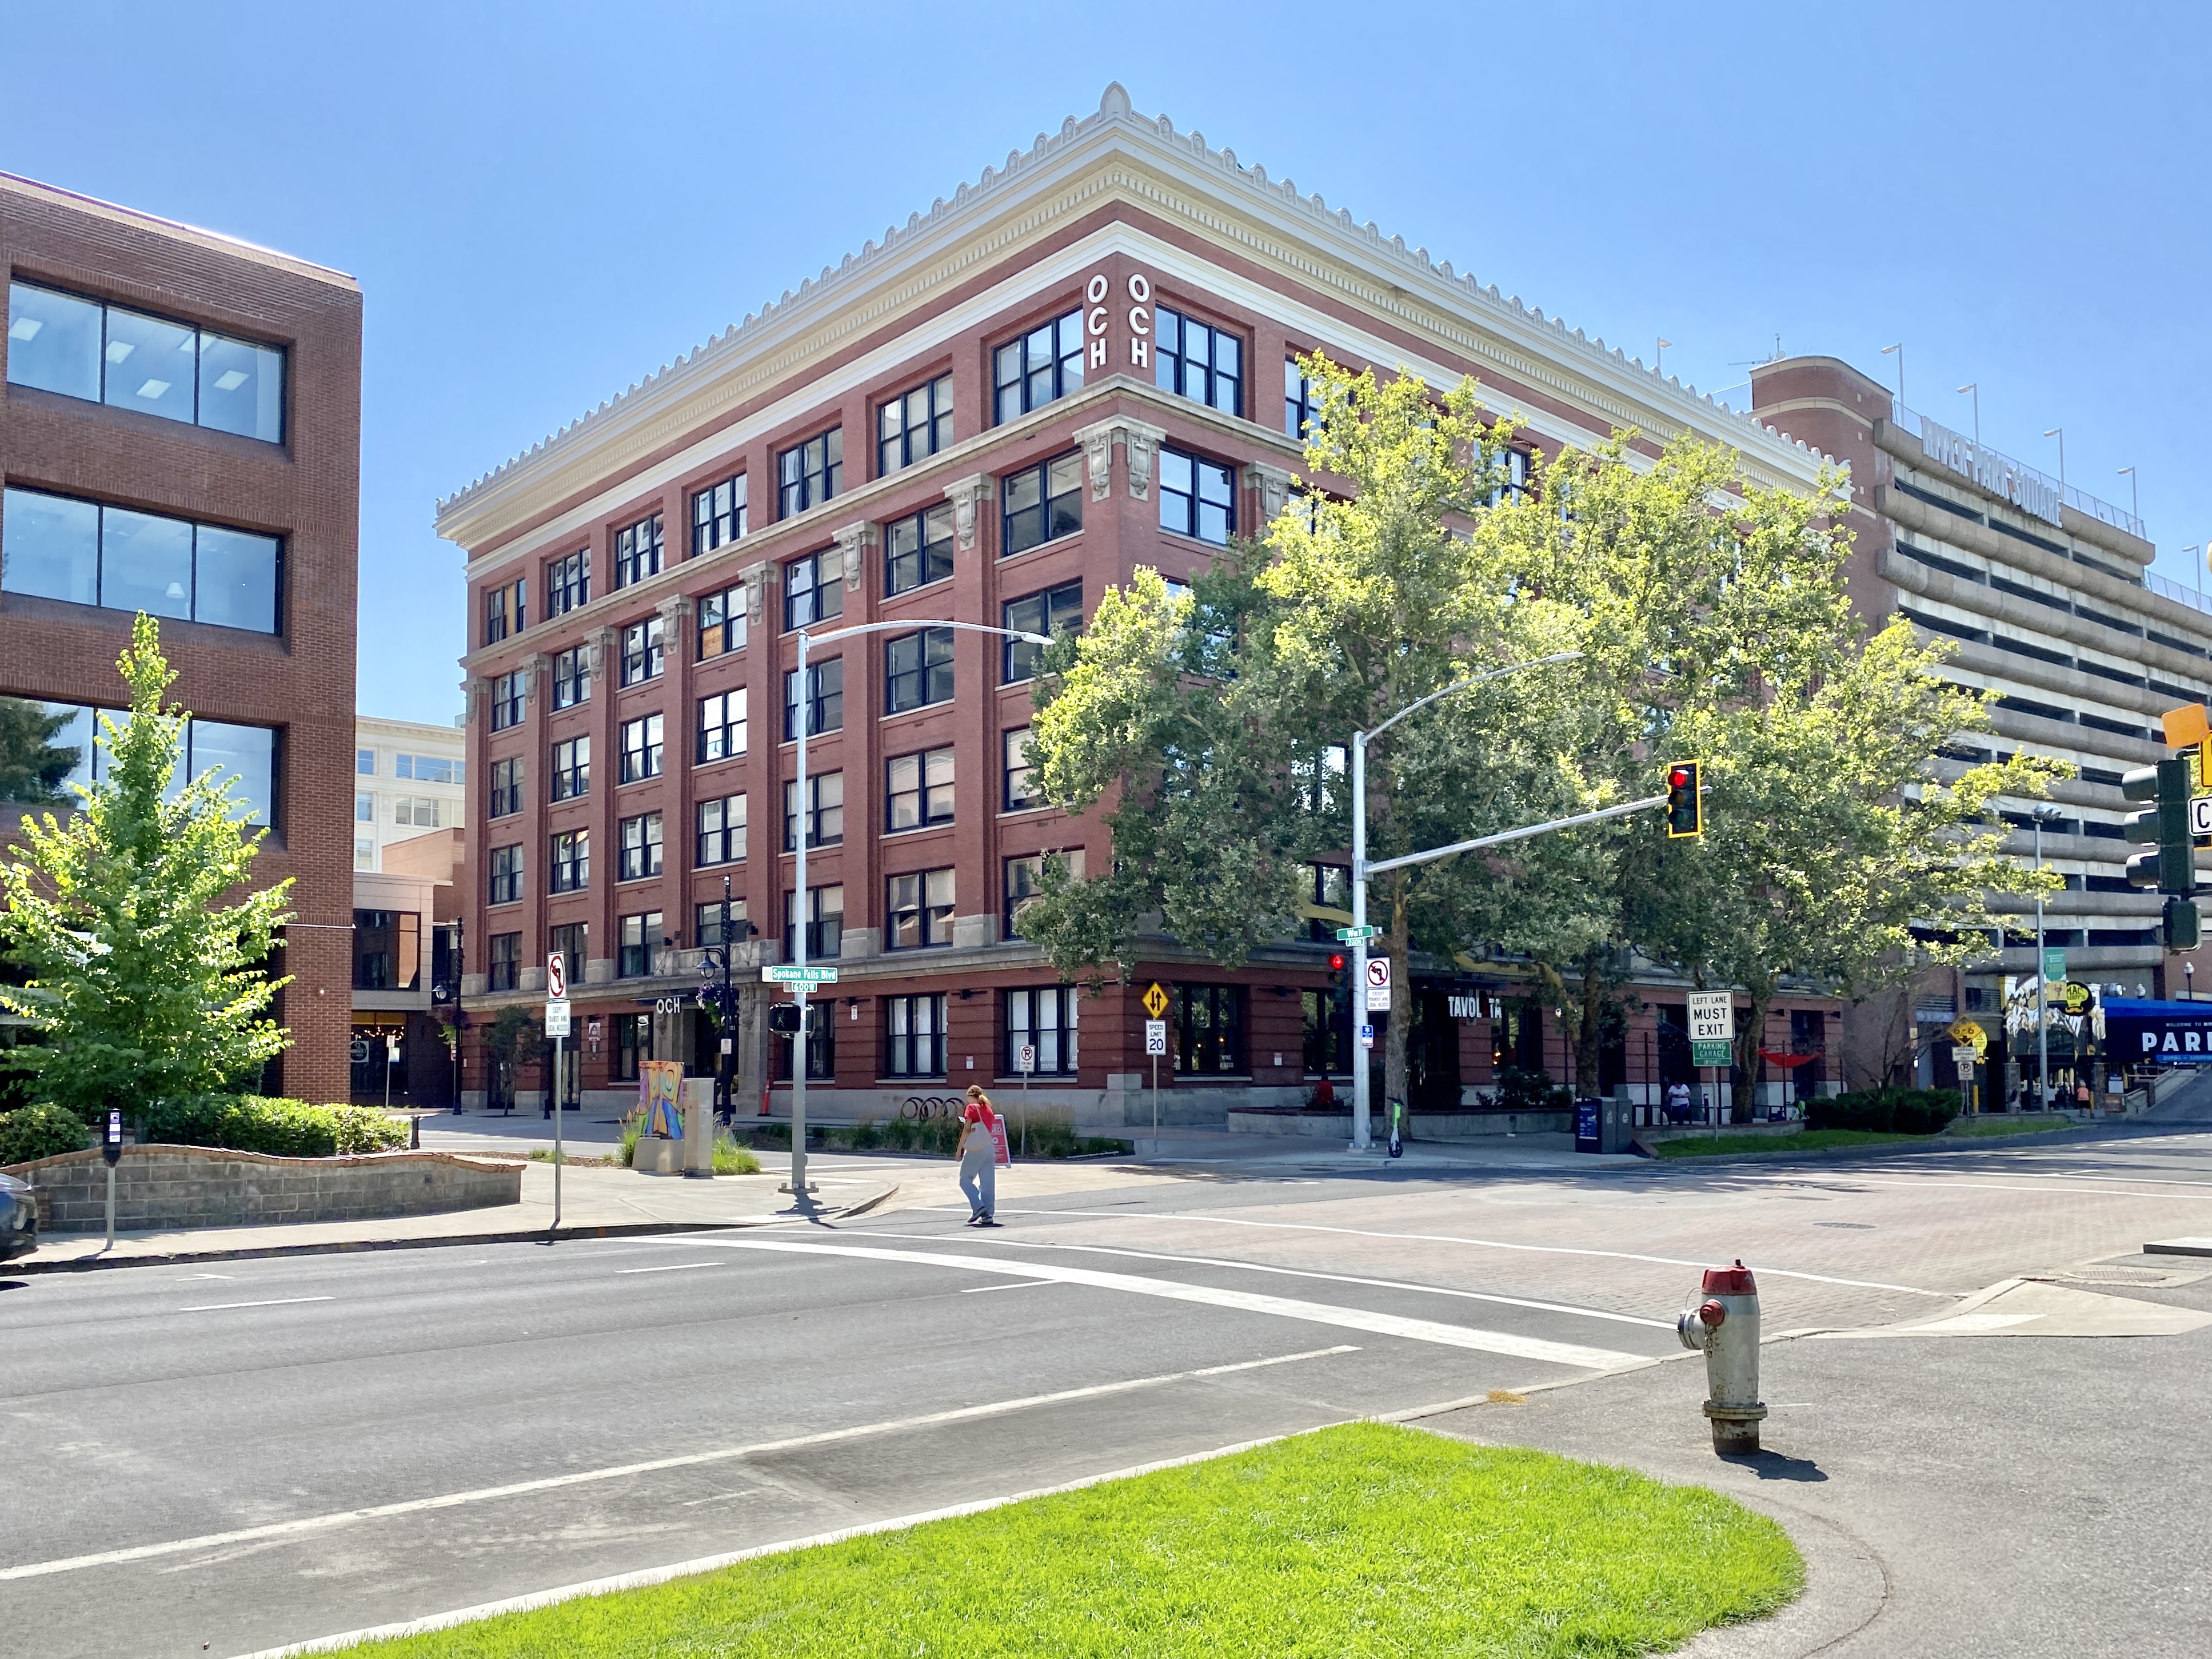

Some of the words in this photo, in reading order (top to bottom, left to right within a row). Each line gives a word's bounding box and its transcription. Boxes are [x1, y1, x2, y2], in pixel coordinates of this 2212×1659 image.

[1087, 274, 1108, 369] OCH
[1128, 273, 1150, 368] OCH
[1922, 415, 1969, 477] RIVER
[1972, 444, 2010, 500] PARK
[2011, 468, 2062, 529] SQUARE
[1347, 929, 1363, 938] Wall
[773, 968, 801, 980] Spokane
[804, 969, 819, 979] Falls
[821, 970, 836, 980] Blvd
[794, 983, 815, 991] 600W
[656, 997, 680, 1014] OCH
[1711, 996, 1727, 1004] LANE
[1448, 996, 1502, 1019] TAVOLTA
[1694, 1007, 1727, 1020] MUST
[1698, 1024, 1724, 1035] EXIT
[1149, 1038, 1164, 1050] 20
